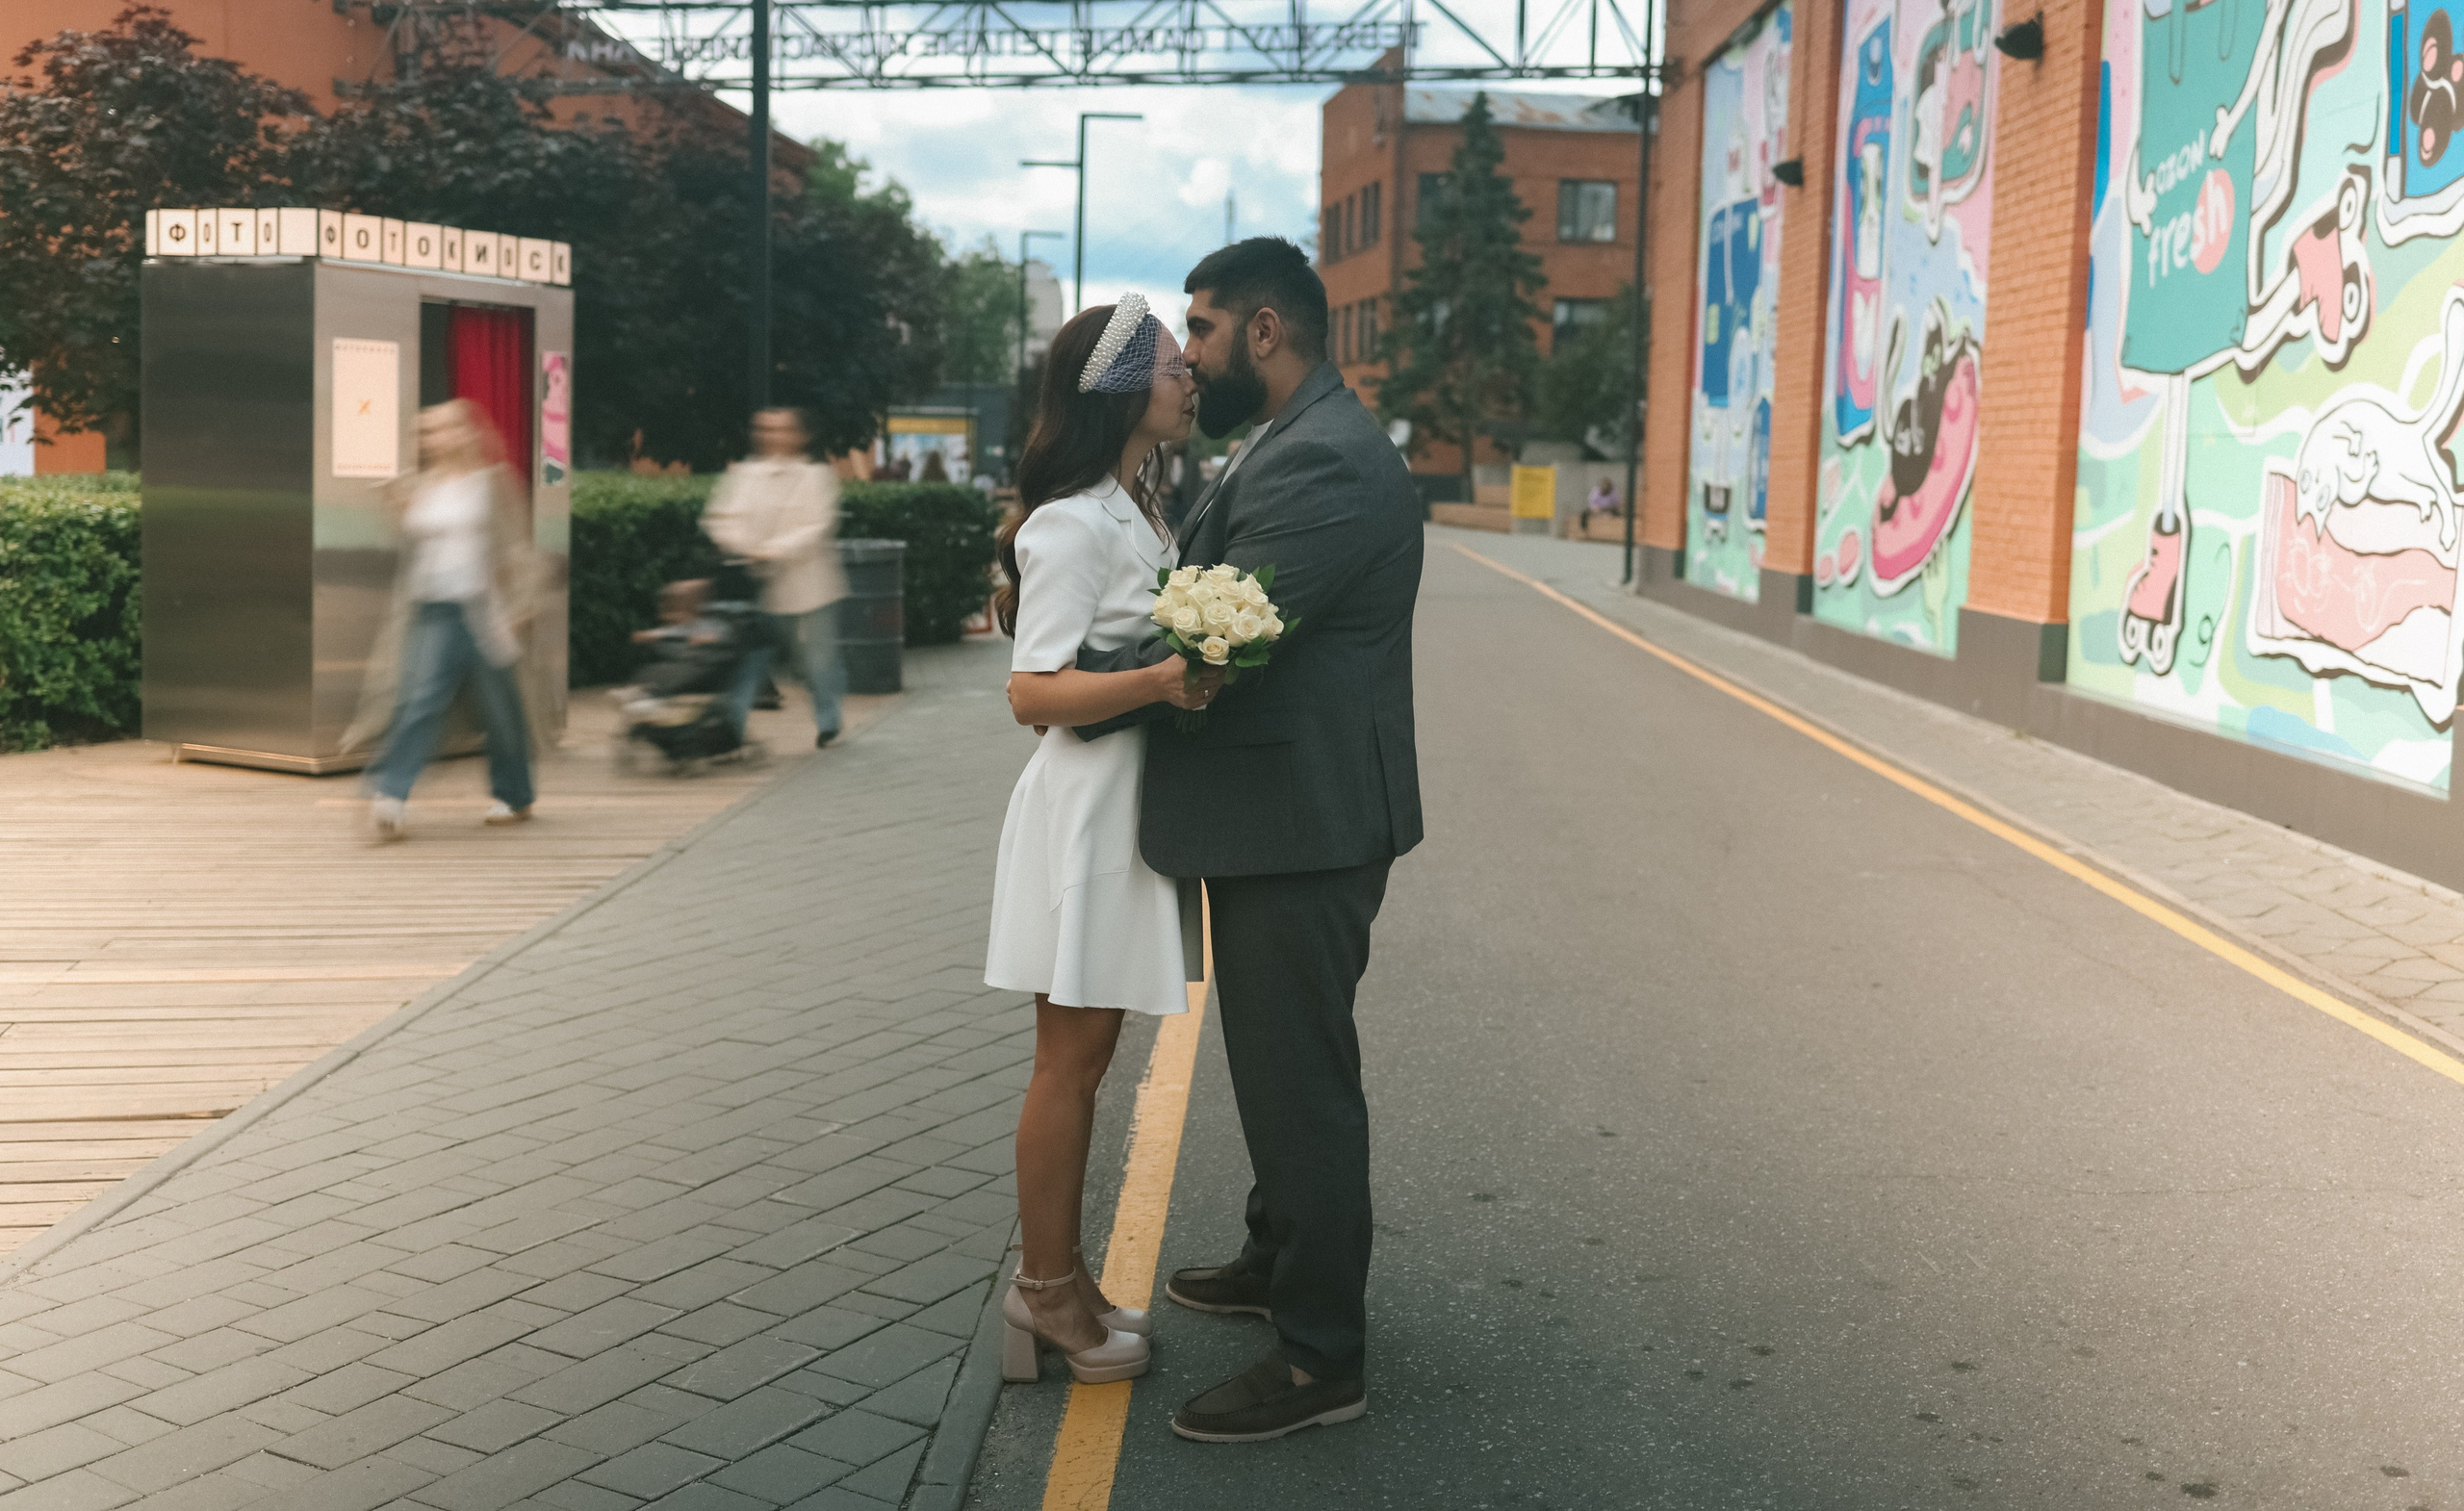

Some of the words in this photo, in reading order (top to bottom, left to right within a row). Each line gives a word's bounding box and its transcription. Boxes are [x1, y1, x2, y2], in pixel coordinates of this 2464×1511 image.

[168, 221, 273, 243] ФОТО
[324, 222, 566, 274] ФОТОКИОСК
[2147, 168, 2229, 289] fresh
